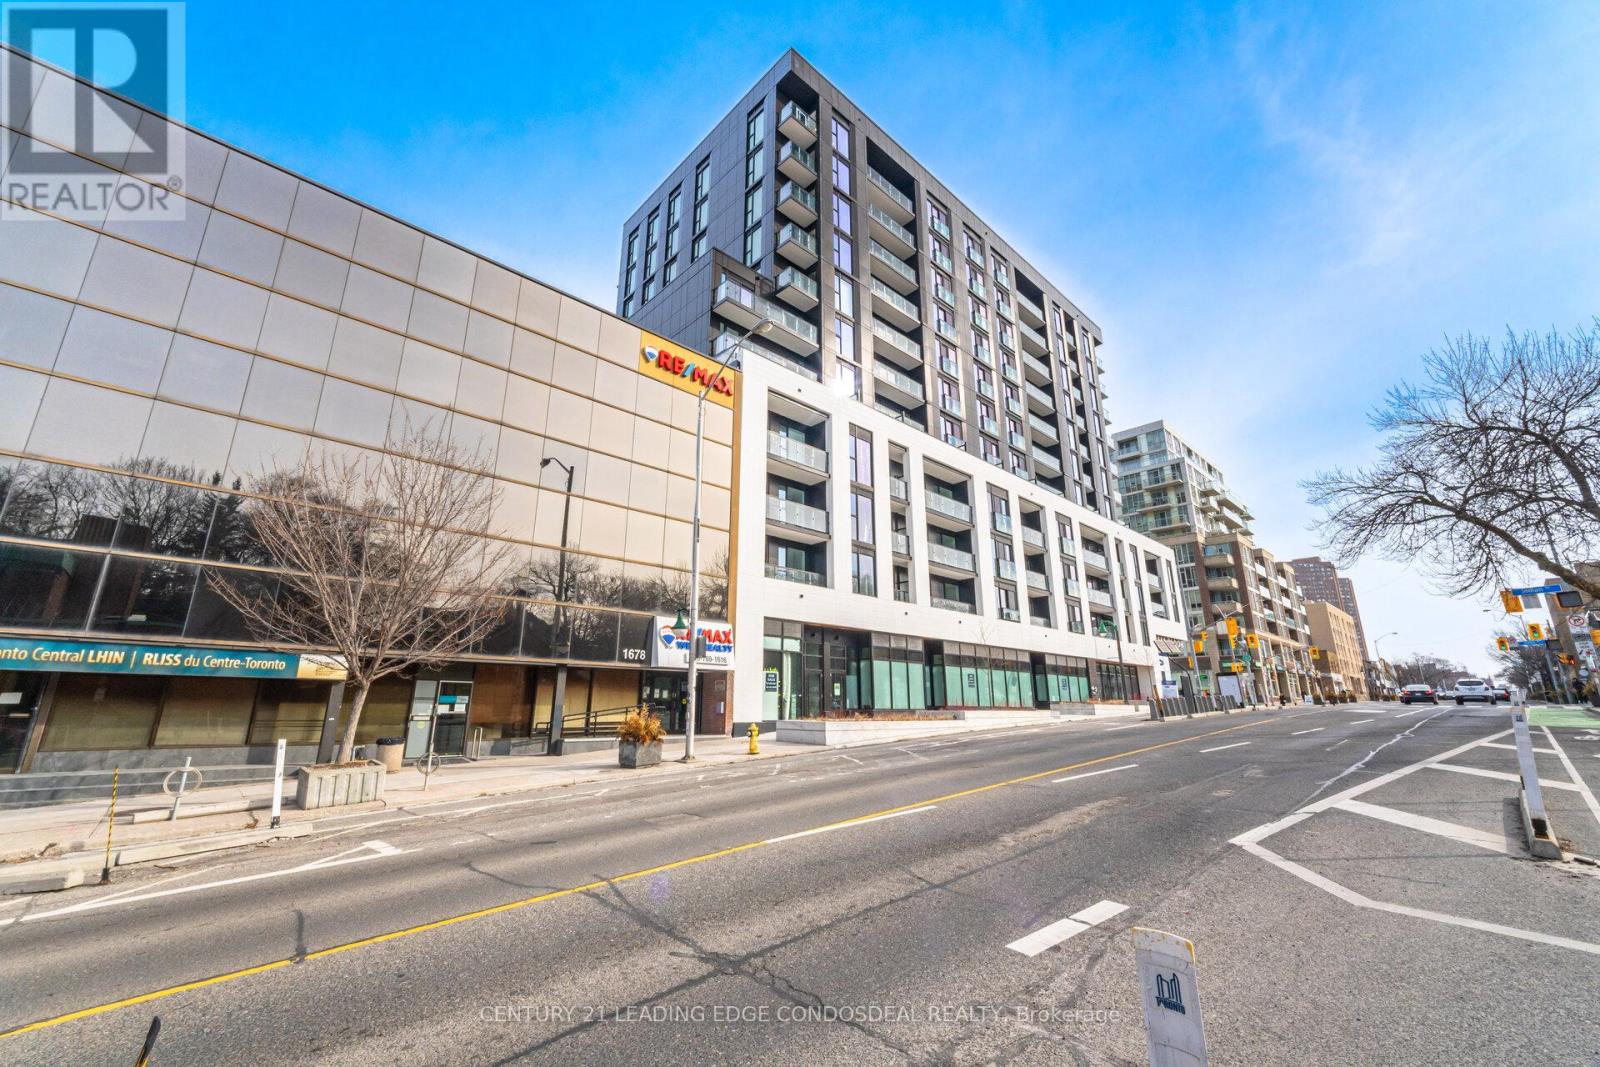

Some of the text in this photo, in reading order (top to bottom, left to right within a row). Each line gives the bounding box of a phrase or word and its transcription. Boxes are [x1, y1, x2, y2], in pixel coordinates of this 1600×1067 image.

[658, 349, 733, 396] RE/MAX
[32, 647, 85, 662] Central
[87, 650, 125, 664] LHIN
[142, 653, 181, 666] RLISS
[184, 655, 200, 667] du
[203, 655, 286, 670] Centre-Toronto
[623, 648, 646, 660] 1678
